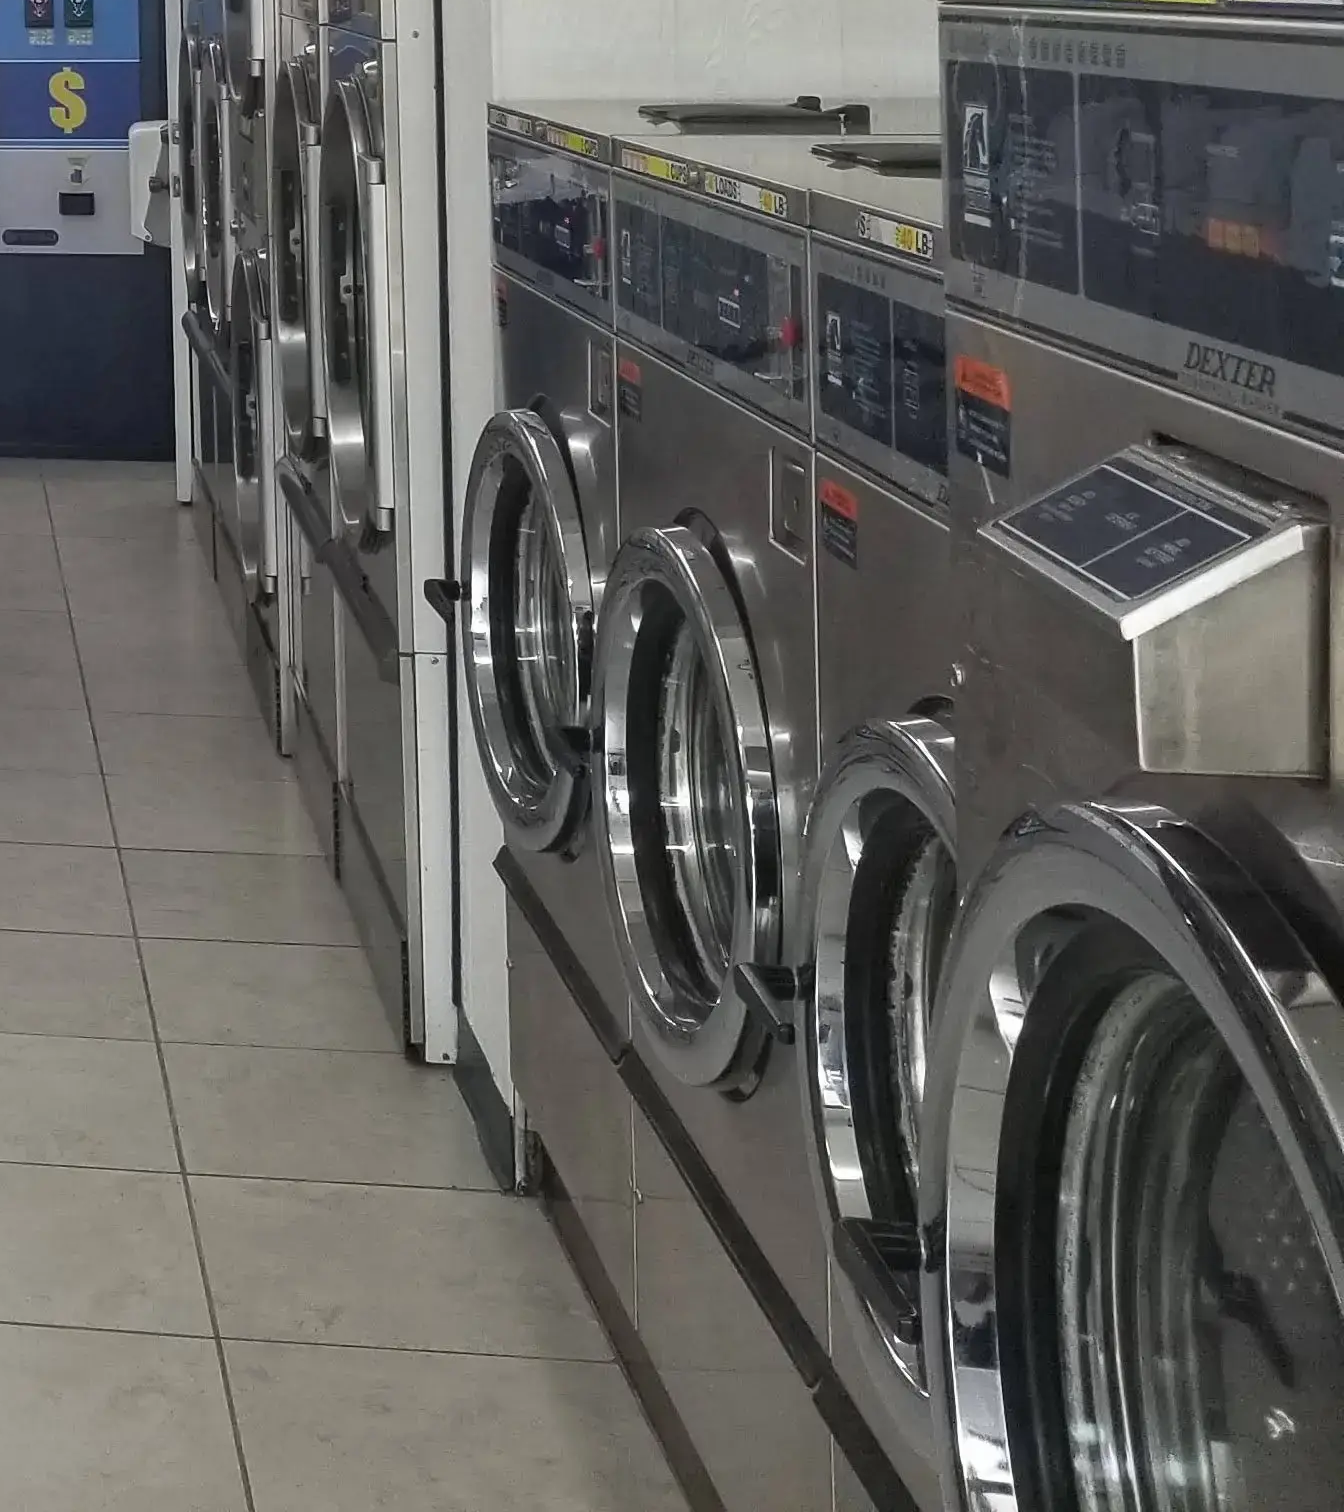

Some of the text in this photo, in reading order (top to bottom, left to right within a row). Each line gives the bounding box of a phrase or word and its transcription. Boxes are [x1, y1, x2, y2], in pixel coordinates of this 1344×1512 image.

[48, 66, 87, 134] $
[774, 193, 786, 216] LB
[915, 230, 928, 255] LB
[1183, 341, 1276, 398] DEXTER
